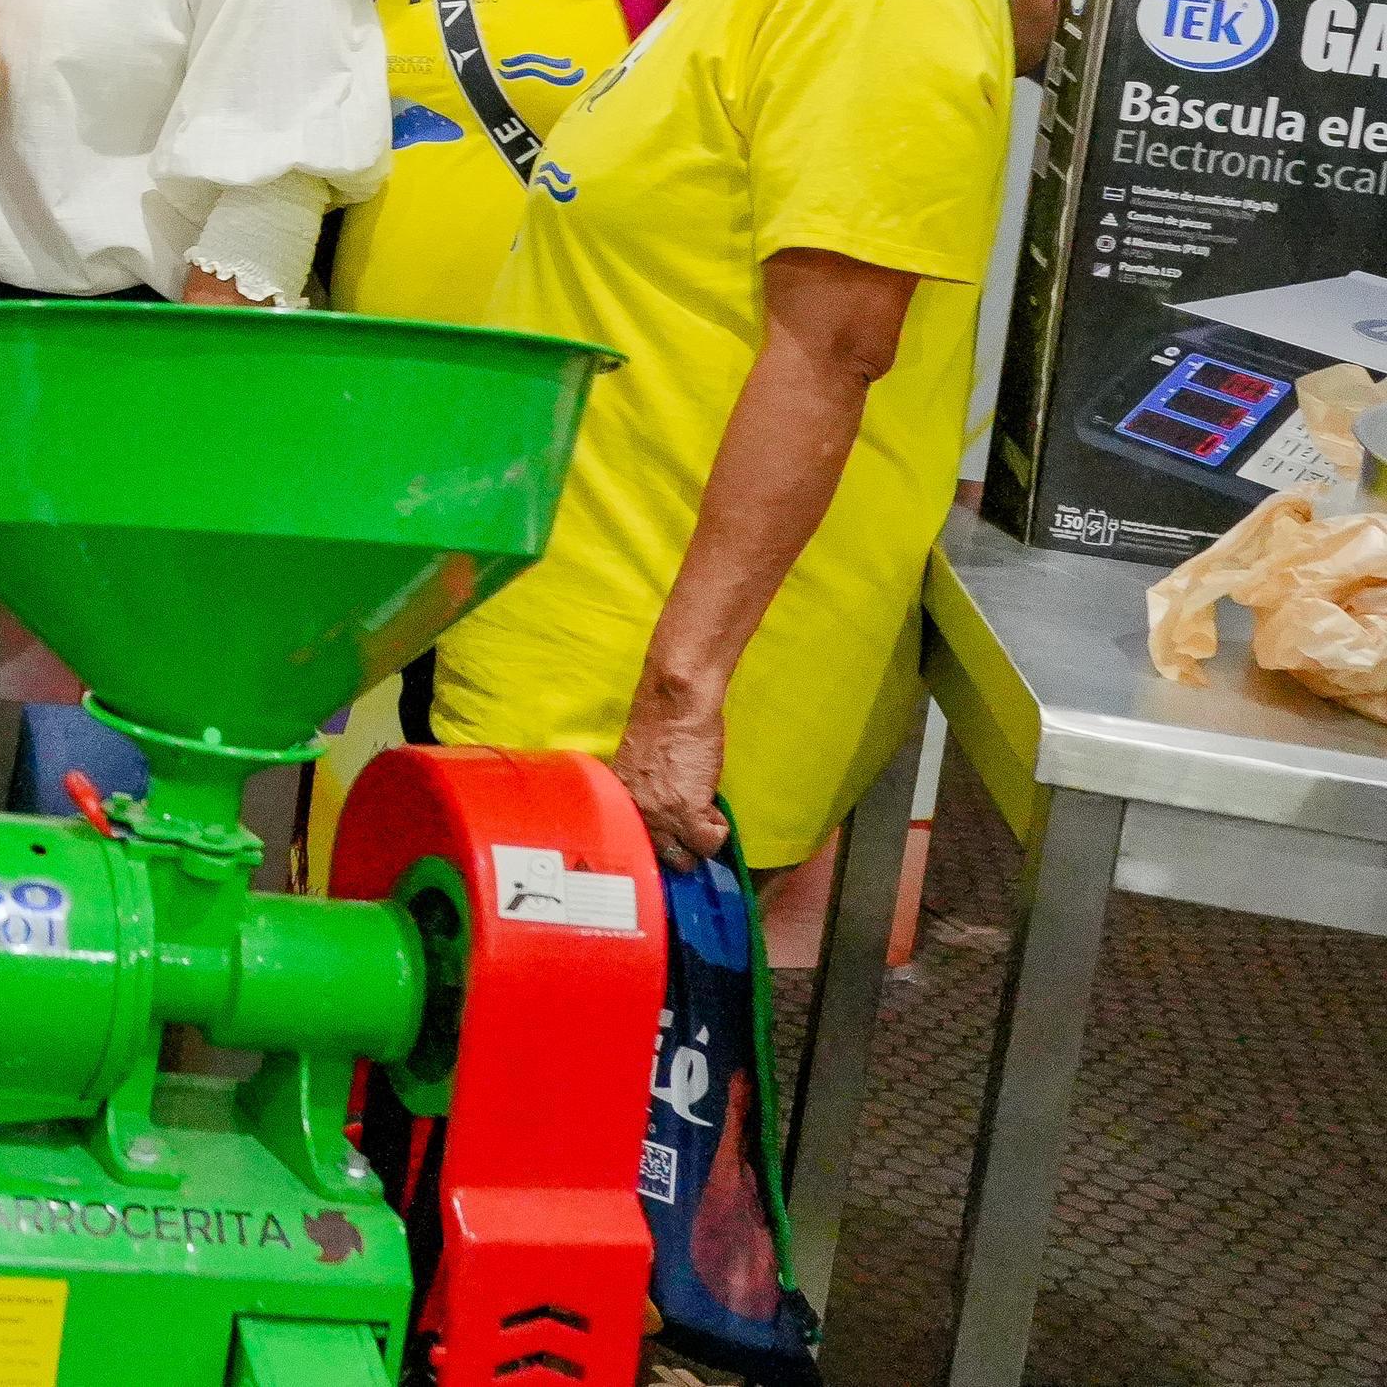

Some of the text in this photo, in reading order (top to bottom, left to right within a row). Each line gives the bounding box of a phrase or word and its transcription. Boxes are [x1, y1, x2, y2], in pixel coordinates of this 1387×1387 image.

[1119, 81, 1306, 142] Báscula
[1112, 129, 1307, 186] Electronic
[1054, 513, 1085, 531] 150
